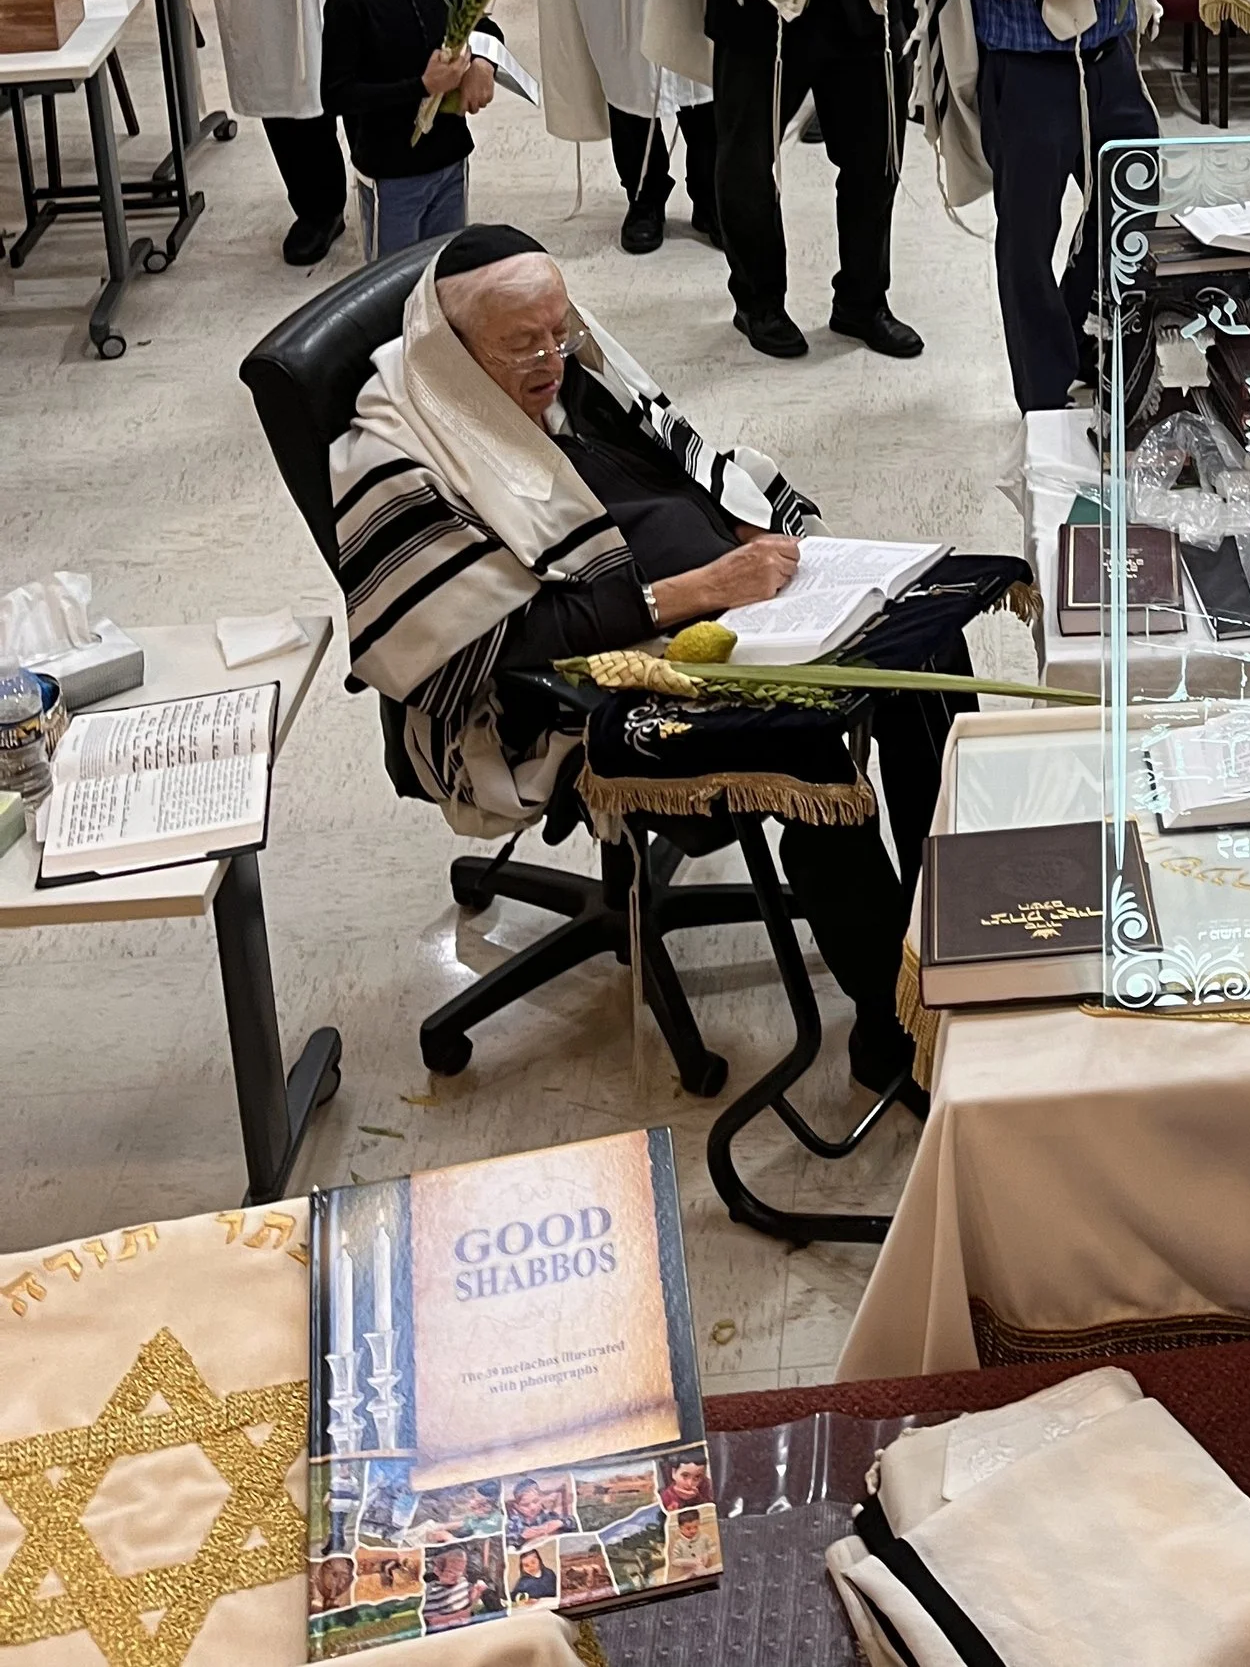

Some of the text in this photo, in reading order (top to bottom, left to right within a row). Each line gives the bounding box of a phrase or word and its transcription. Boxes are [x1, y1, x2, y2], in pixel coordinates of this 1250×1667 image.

[0, 1210, 309, 1319] תר תורה
[453, 1203, 613, 1266] GOOD
[454, 1241, 617, 1303] SHABBOS
[461, 1371, 484, 1384] The
[501, 1355, 560, 1375] melachos
[561, 1339, 626, 1362] illustrated
[488, 1364, 600, 1394] with photographs
